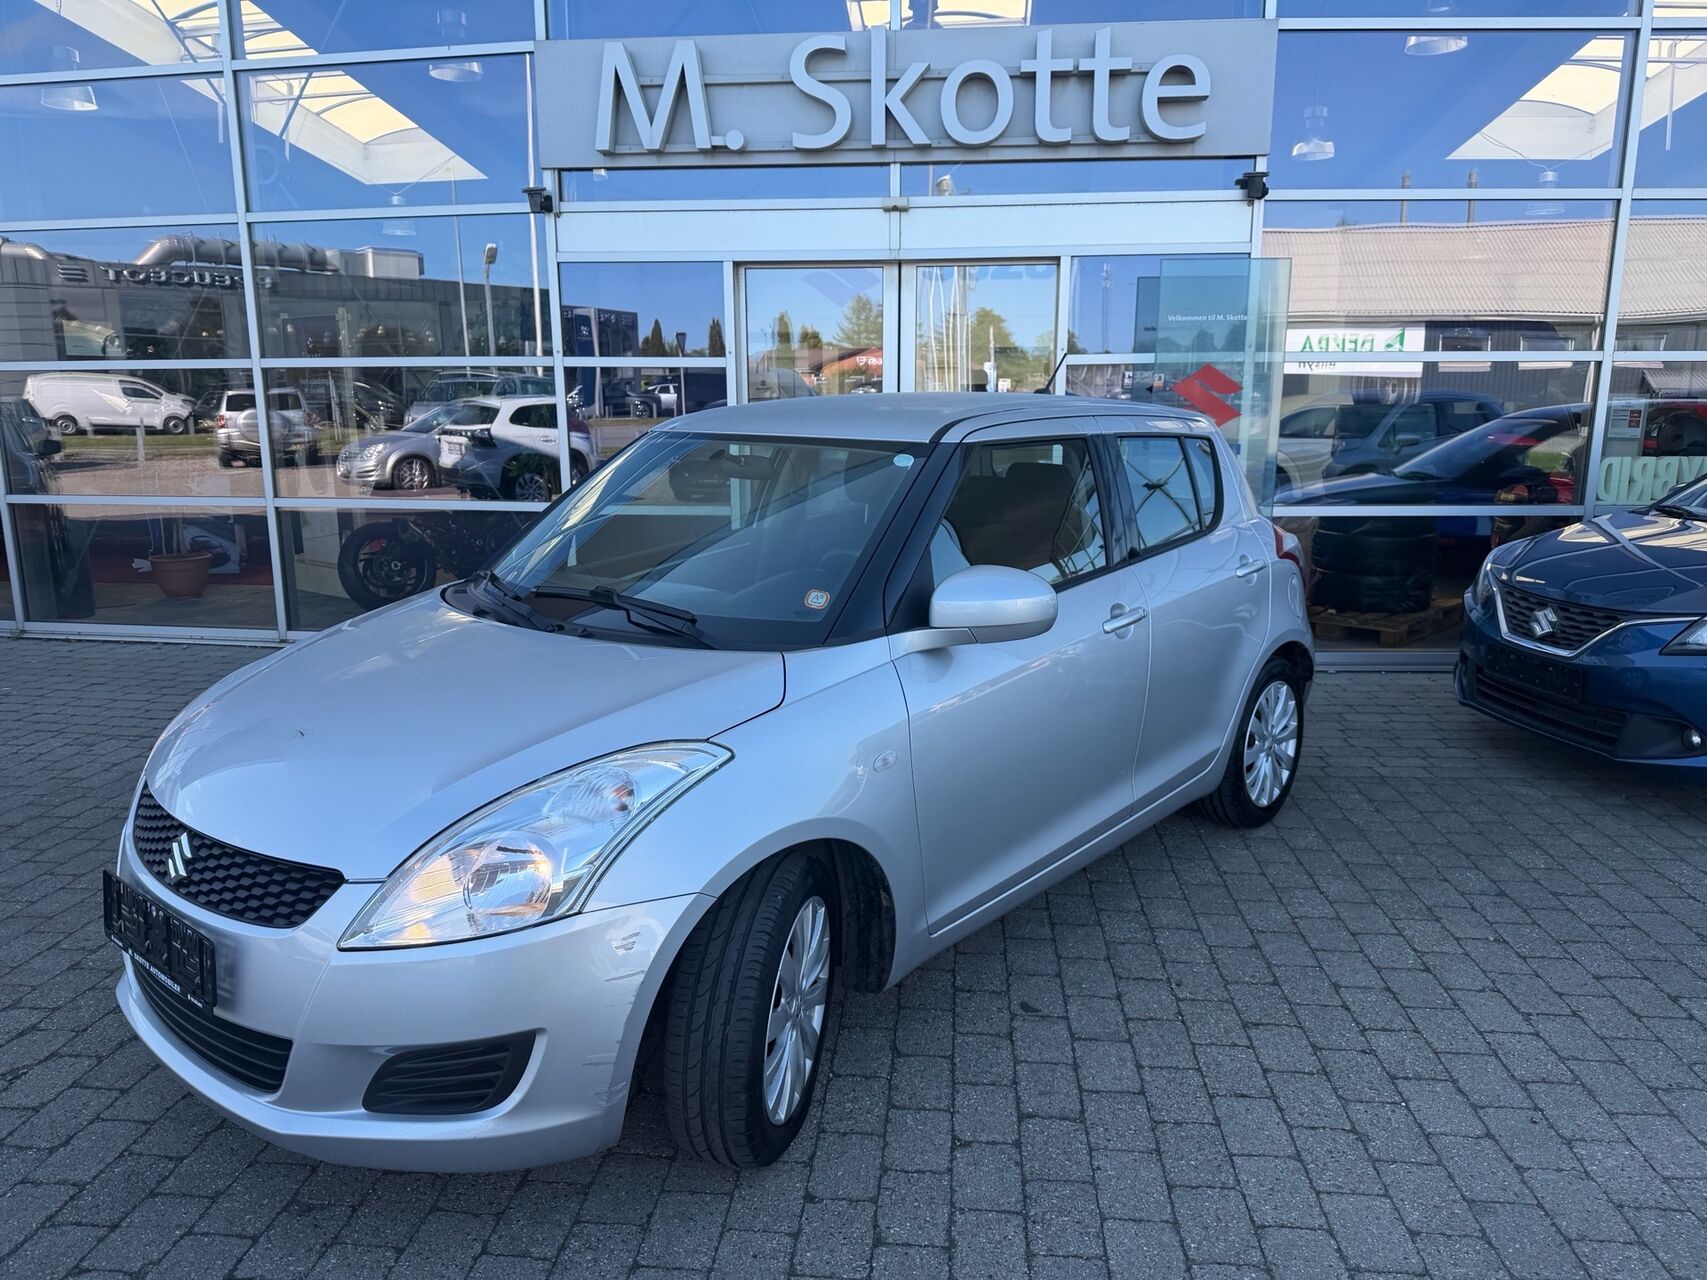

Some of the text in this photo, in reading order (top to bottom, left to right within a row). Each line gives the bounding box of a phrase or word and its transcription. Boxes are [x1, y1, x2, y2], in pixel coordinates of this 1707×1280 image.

[595, 25, 1211, 155] M. Skotte
[1167, 313, 1207, 321] Velkommen
[1226, 313, 1248, 321] Skotte
